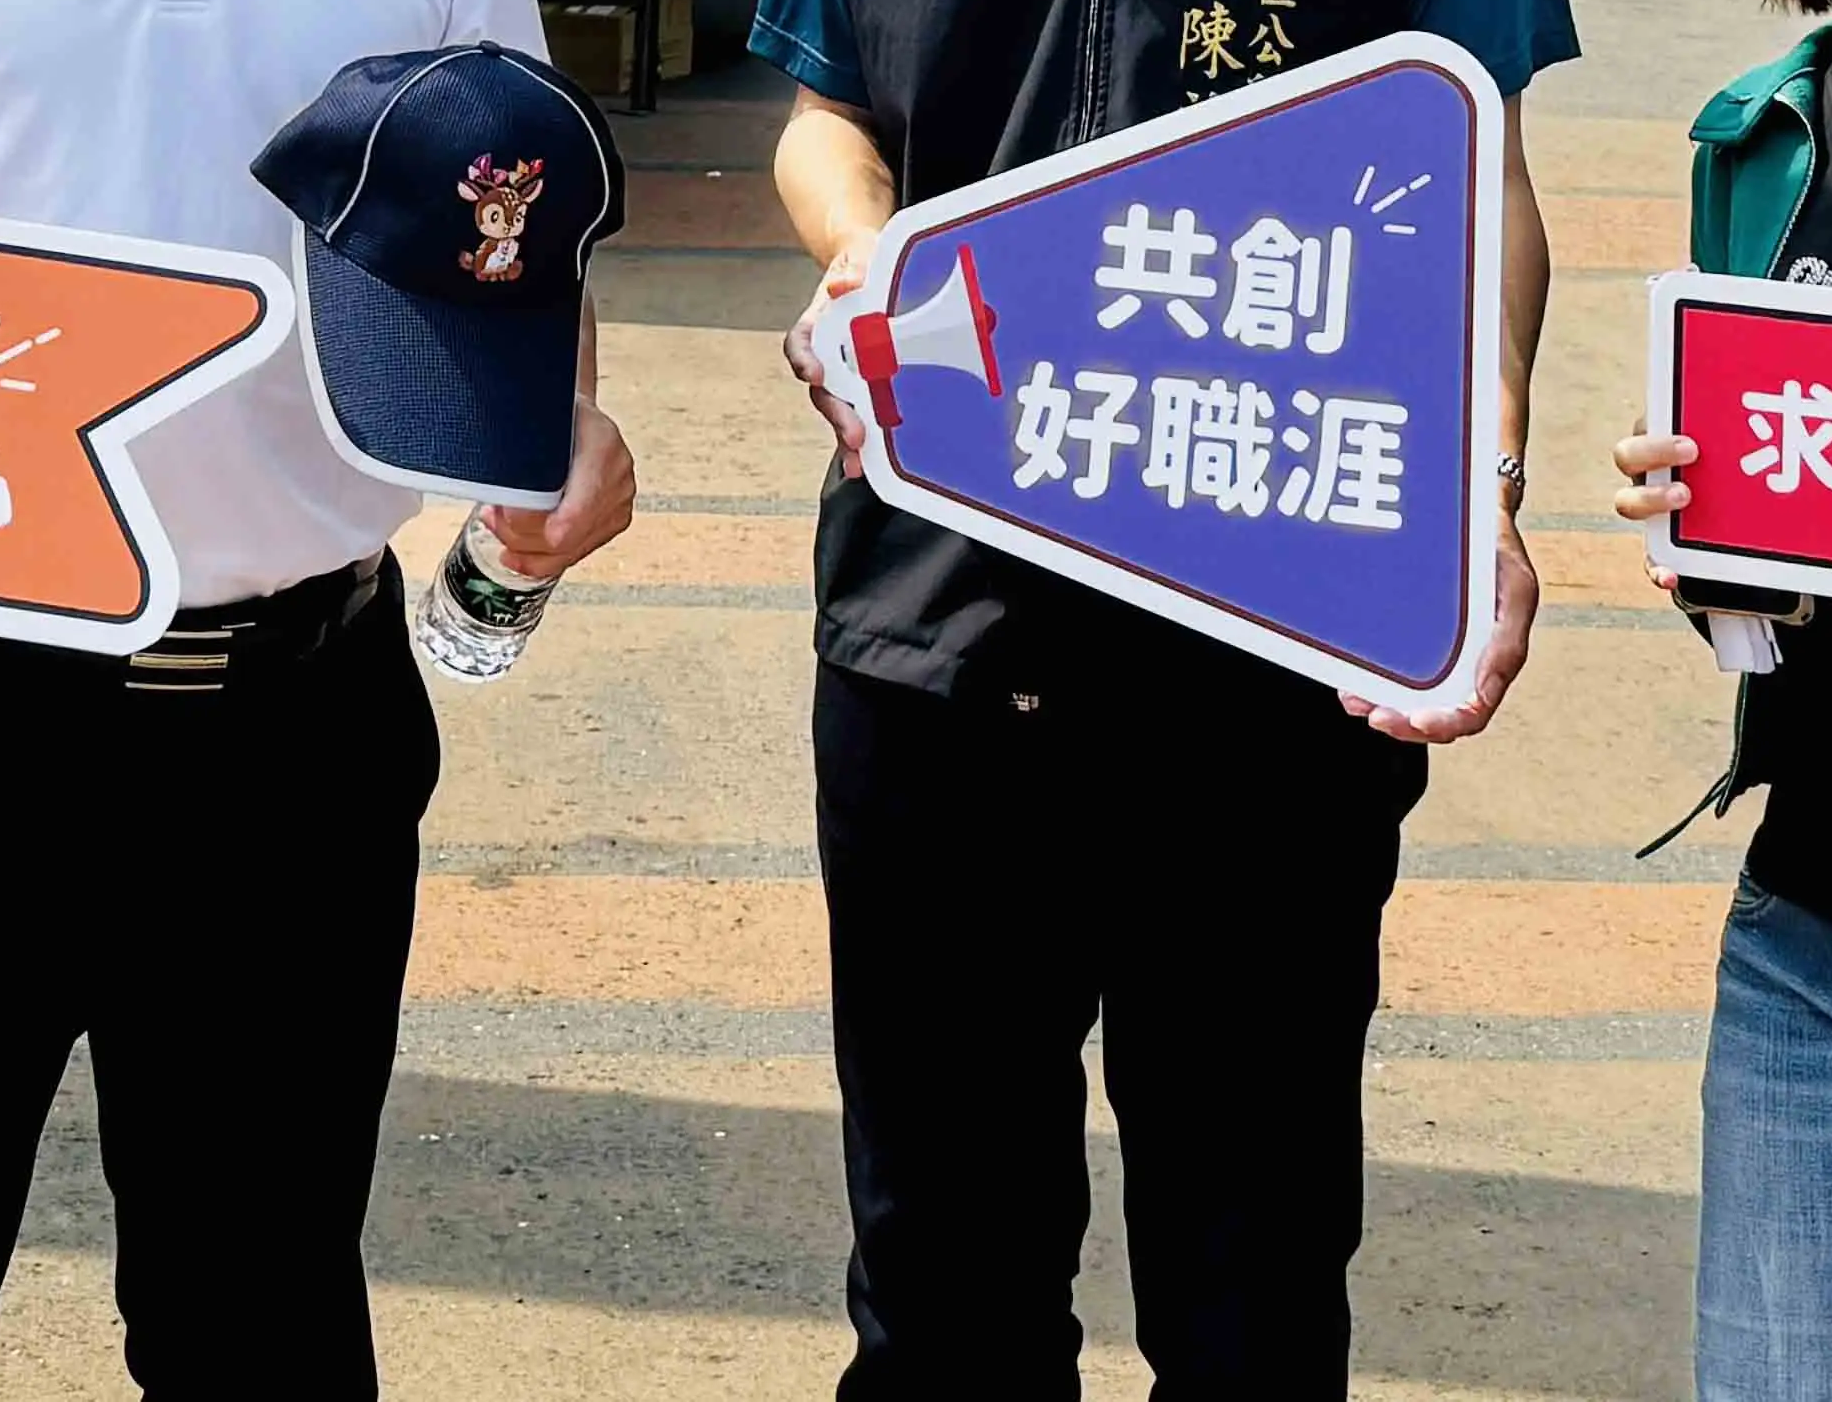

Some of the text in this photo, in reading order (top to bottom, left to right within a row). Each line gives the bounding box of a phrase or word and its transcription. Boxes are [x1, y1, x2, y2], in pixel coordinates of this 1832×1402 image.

[1094, 202, 1353, 355] 共創
[1012, 360, 1409, 532] 好職涯
